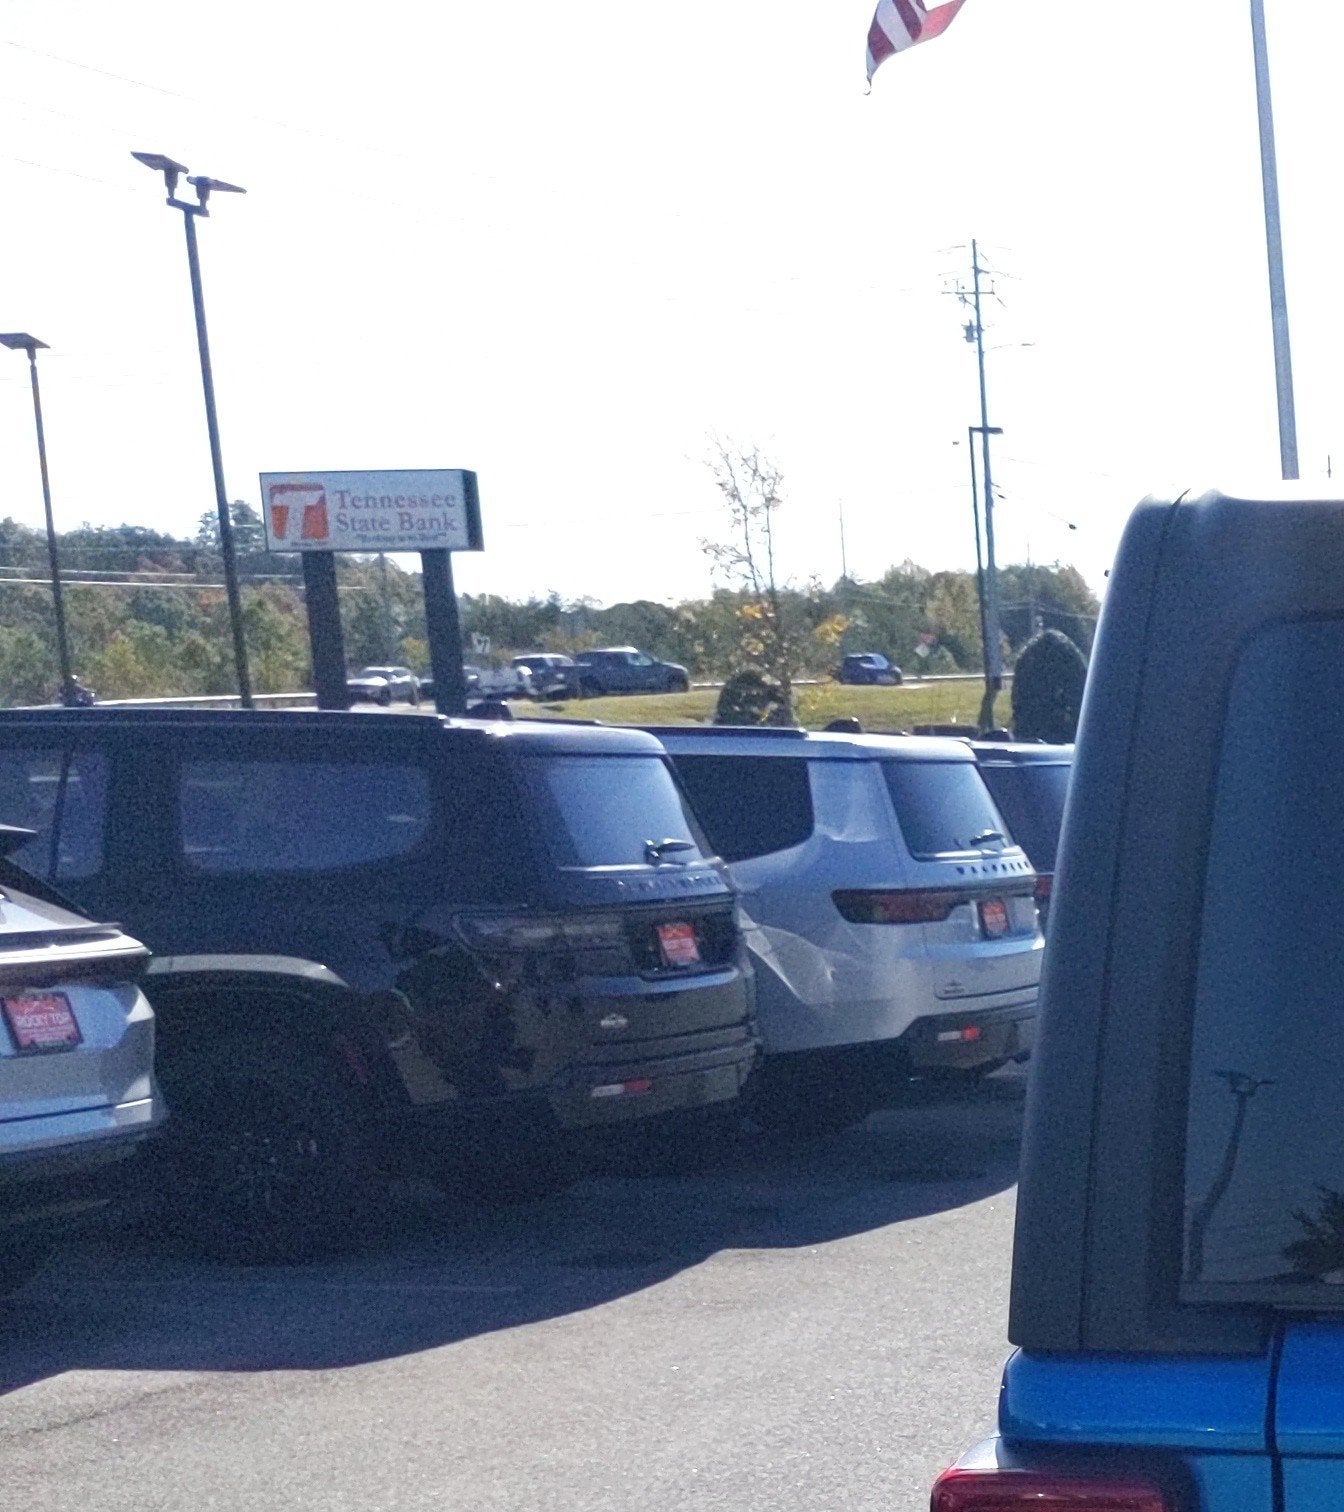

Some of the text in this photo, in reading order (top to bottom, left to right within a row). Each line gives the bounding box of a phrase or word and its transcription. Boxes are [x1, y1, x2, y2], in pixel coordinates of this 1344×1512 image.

[334, 489, 456, 509] Tennessee
[335, 511, 458, 532] State Bank
